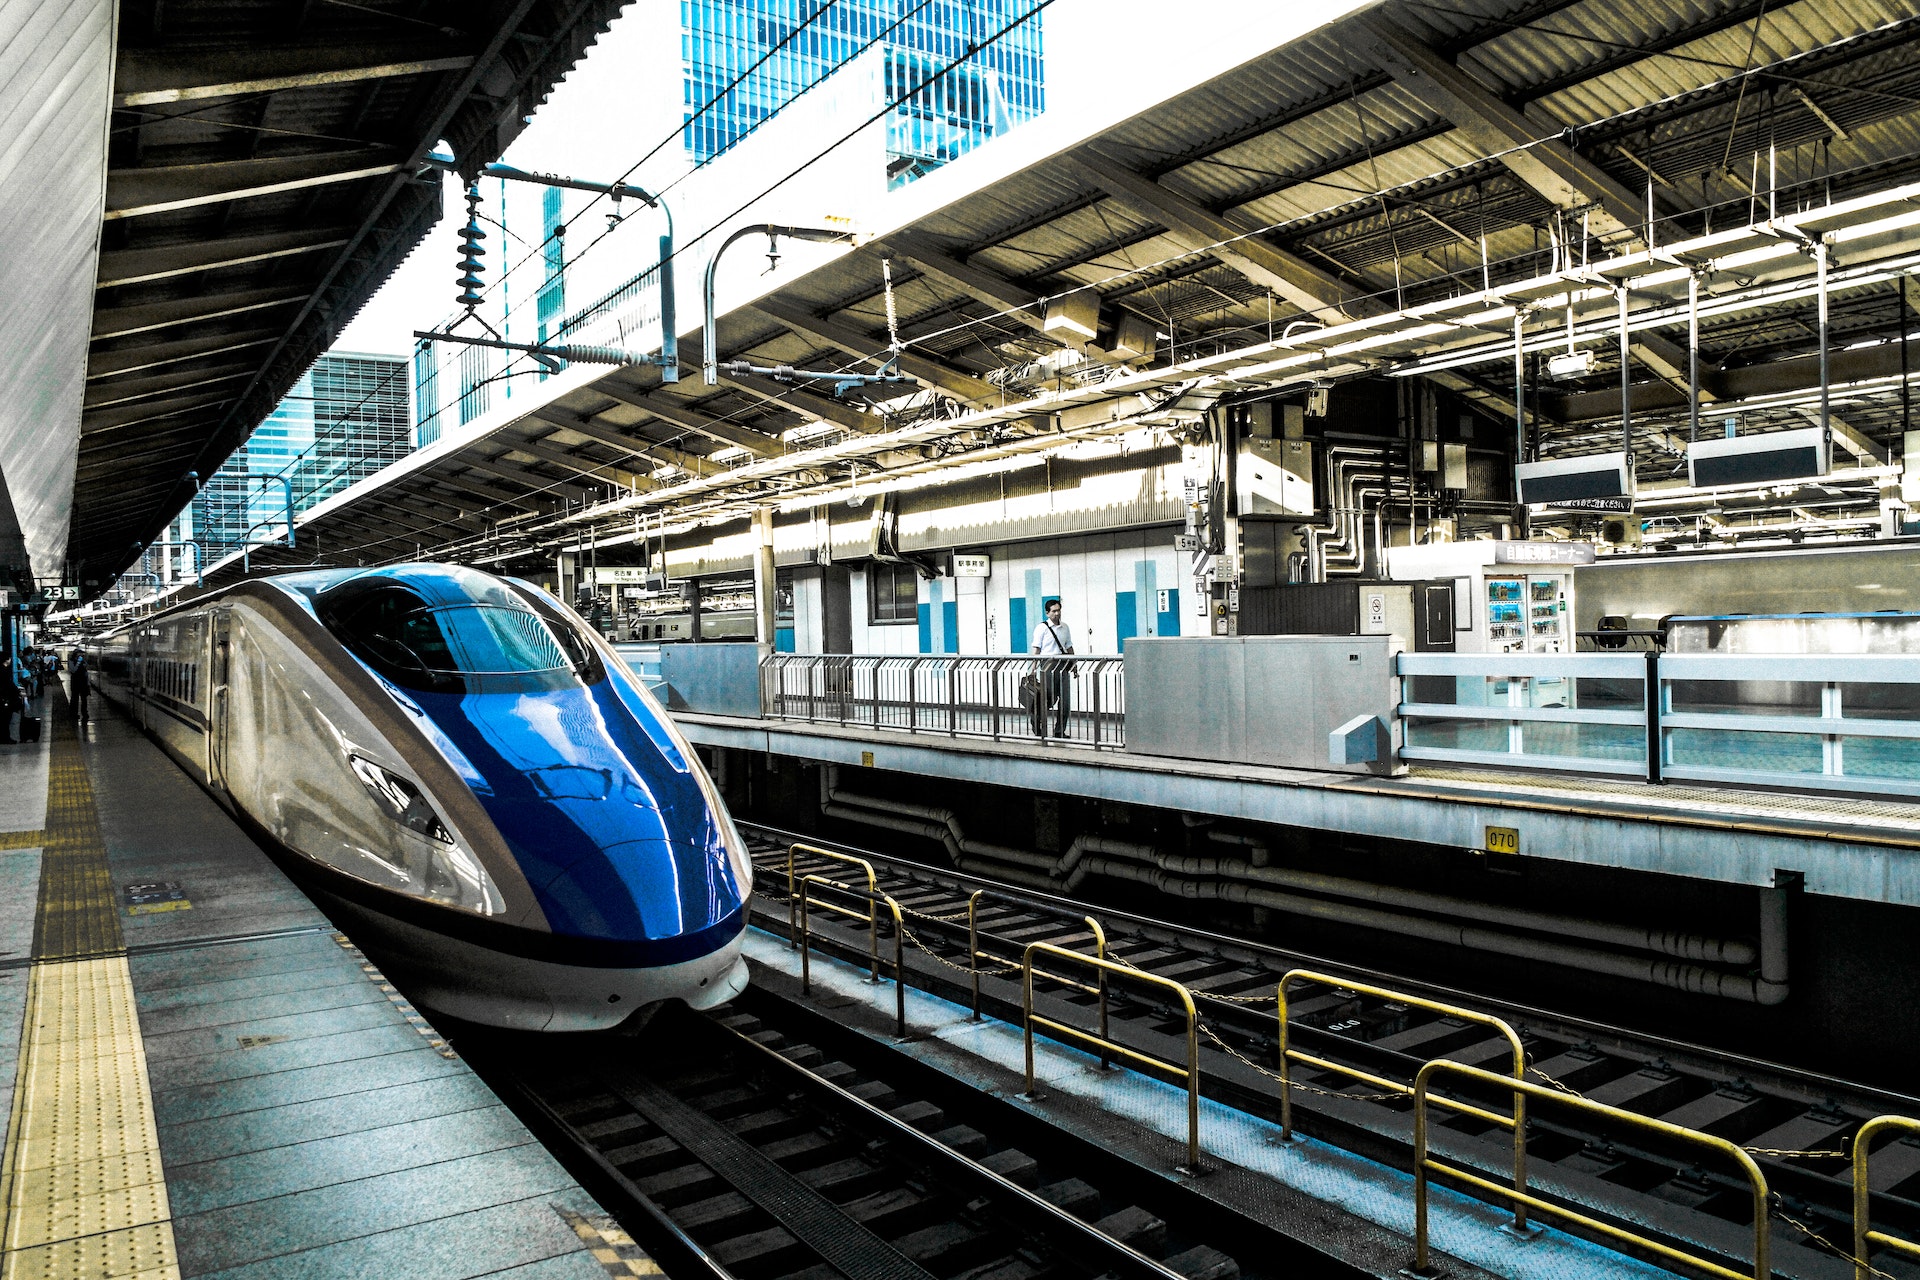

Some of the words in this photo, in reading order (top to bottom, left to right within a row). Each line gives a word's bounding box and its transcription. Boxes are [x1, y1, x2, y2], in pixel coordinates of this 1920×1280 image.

[1825, 431, 1831, 442] 4
[1627, 455, 1633, 465] 5
[44, 586, 63, 600] 23
[1490, 832, 1514, 848] 070
